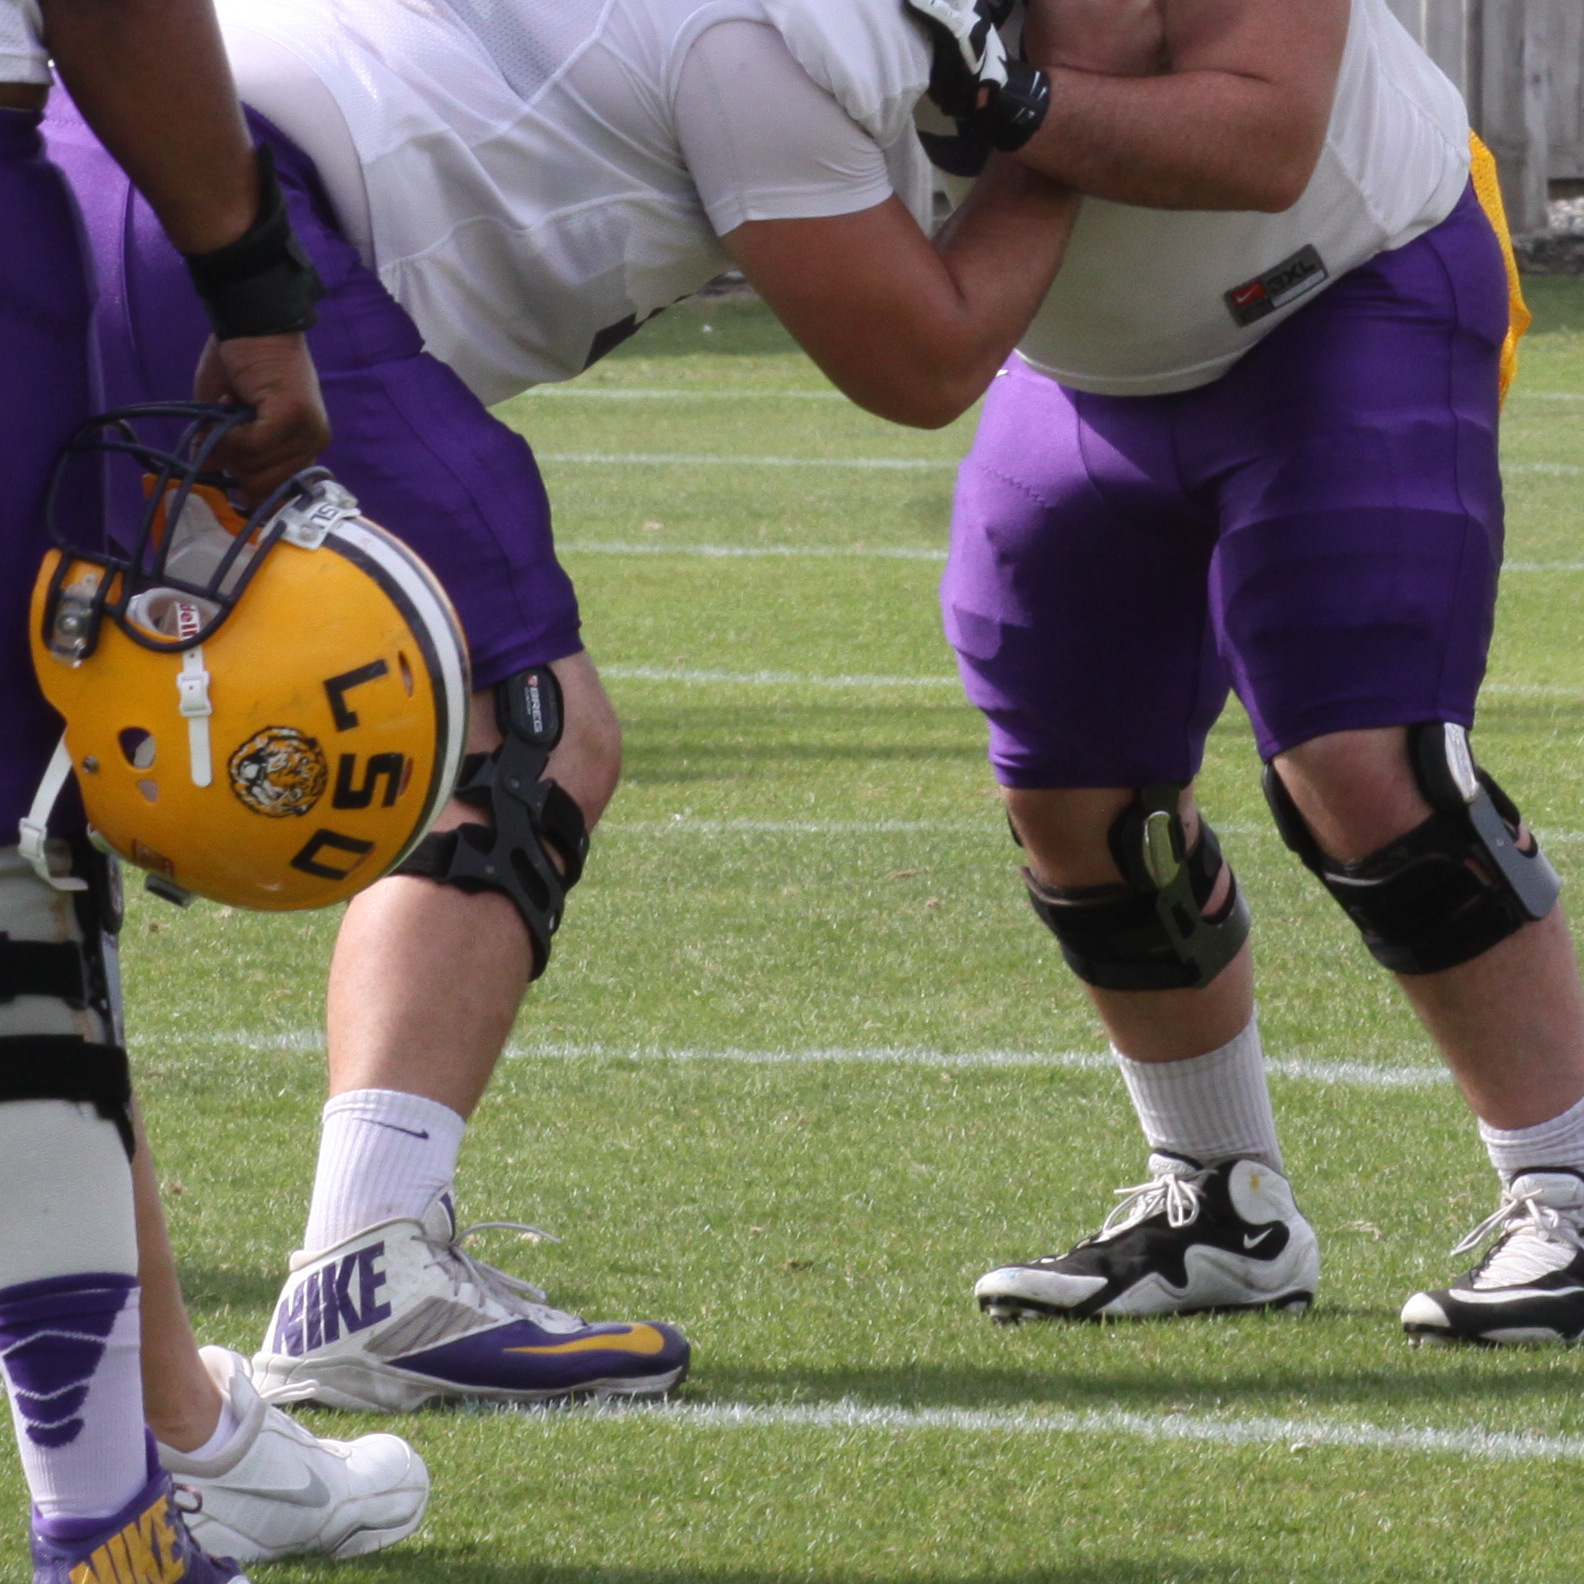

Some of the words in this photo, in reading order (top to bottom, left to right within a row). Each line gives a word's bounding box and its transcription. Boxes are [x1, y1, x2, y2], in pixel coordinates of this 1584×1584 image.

[529, 687, 543, 733] BREG
[289, 658, 405, 881] LSU
[271, 1240, 392, 1357] NIKE
